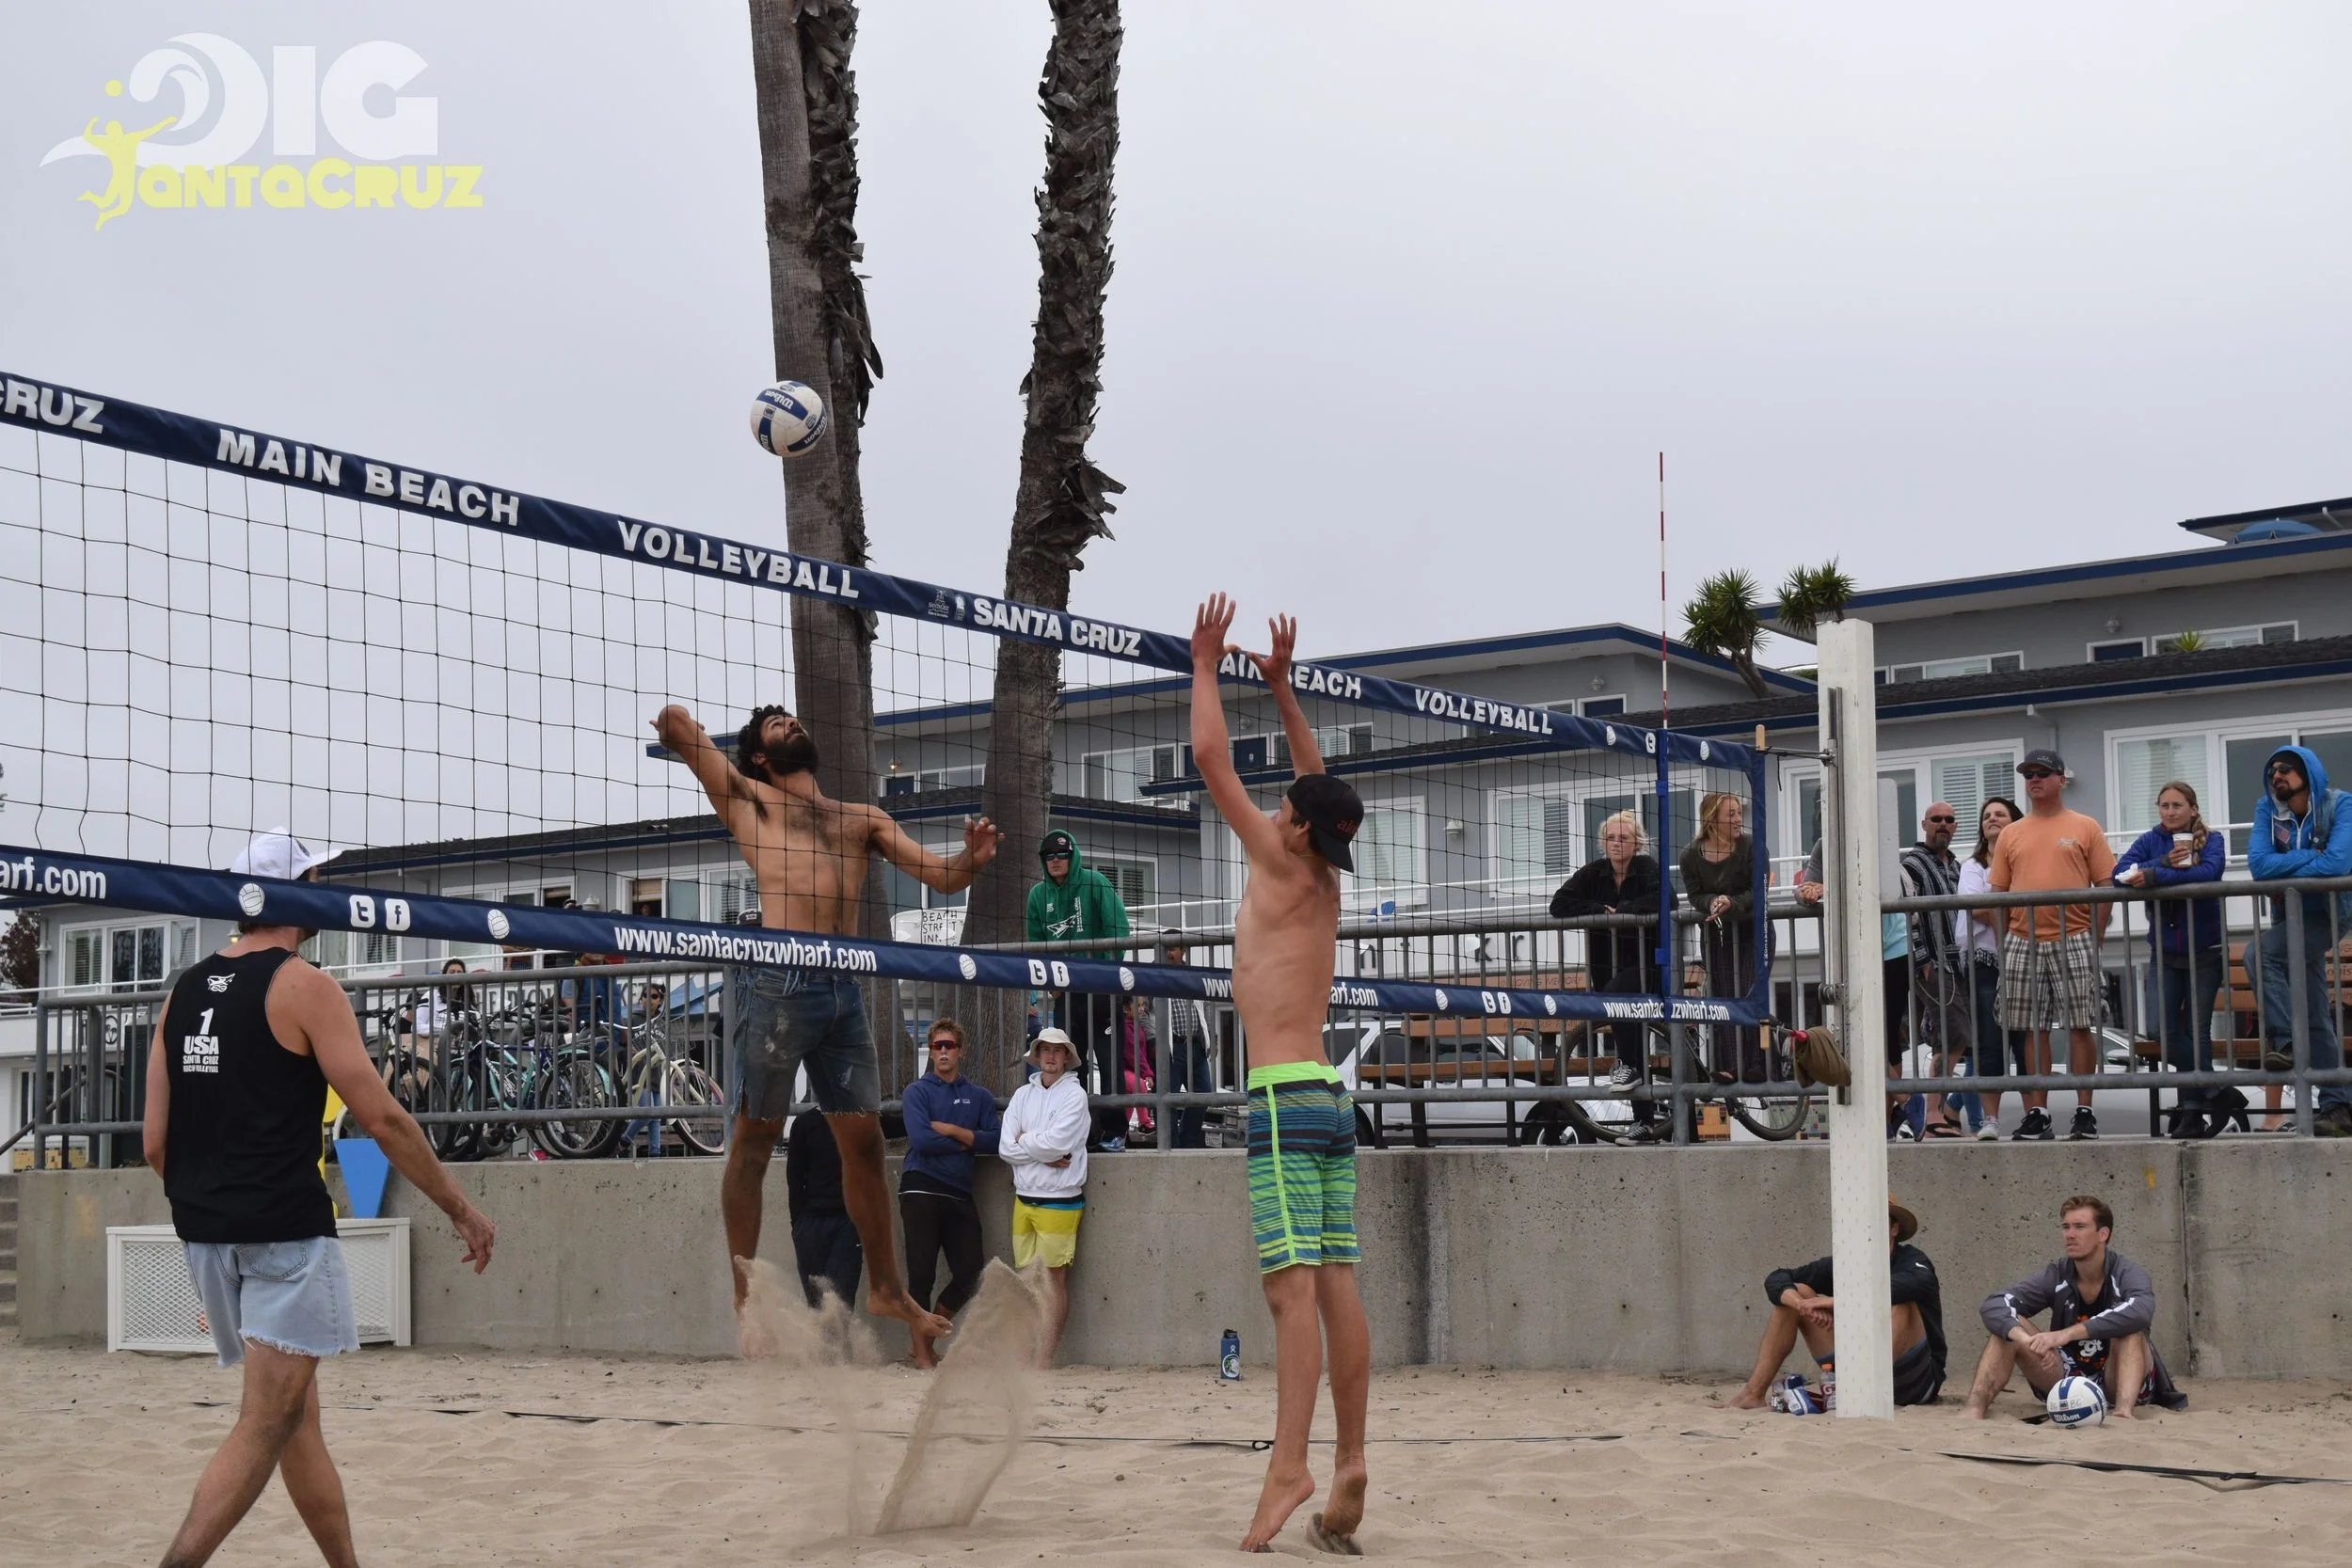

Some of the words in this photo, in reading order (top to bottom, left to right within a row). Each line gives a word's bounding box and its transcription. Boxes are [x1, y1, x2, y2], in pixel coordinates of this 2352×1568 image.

[0, 381, 103, 433] RUZ
[217, 429, 341, 486] MAIN
[365, 464, 518, 526] BEACH
[618, 520, 858, 598] VOLLEYBALL
[974, 598, 1062, 640] SANTA
[1071, 620, 1140, 656] CRUZ
[1216, 653, 1263, 681] AIN
[1288, 666, 1360, 699] EACH
[1415, 689, 1552, 735] VOLLEYBALL
[923, 922, 956, 934] STRET
[614, 927, 877, 972] www.santacruzwharf.com
[1328, 981, 1378, 1006] arf.com
[199, 1007, 214, 1035] 1
[183, 1036, 219, 1054] USA
[2054, 1413, 2081, 1422] Wilson
